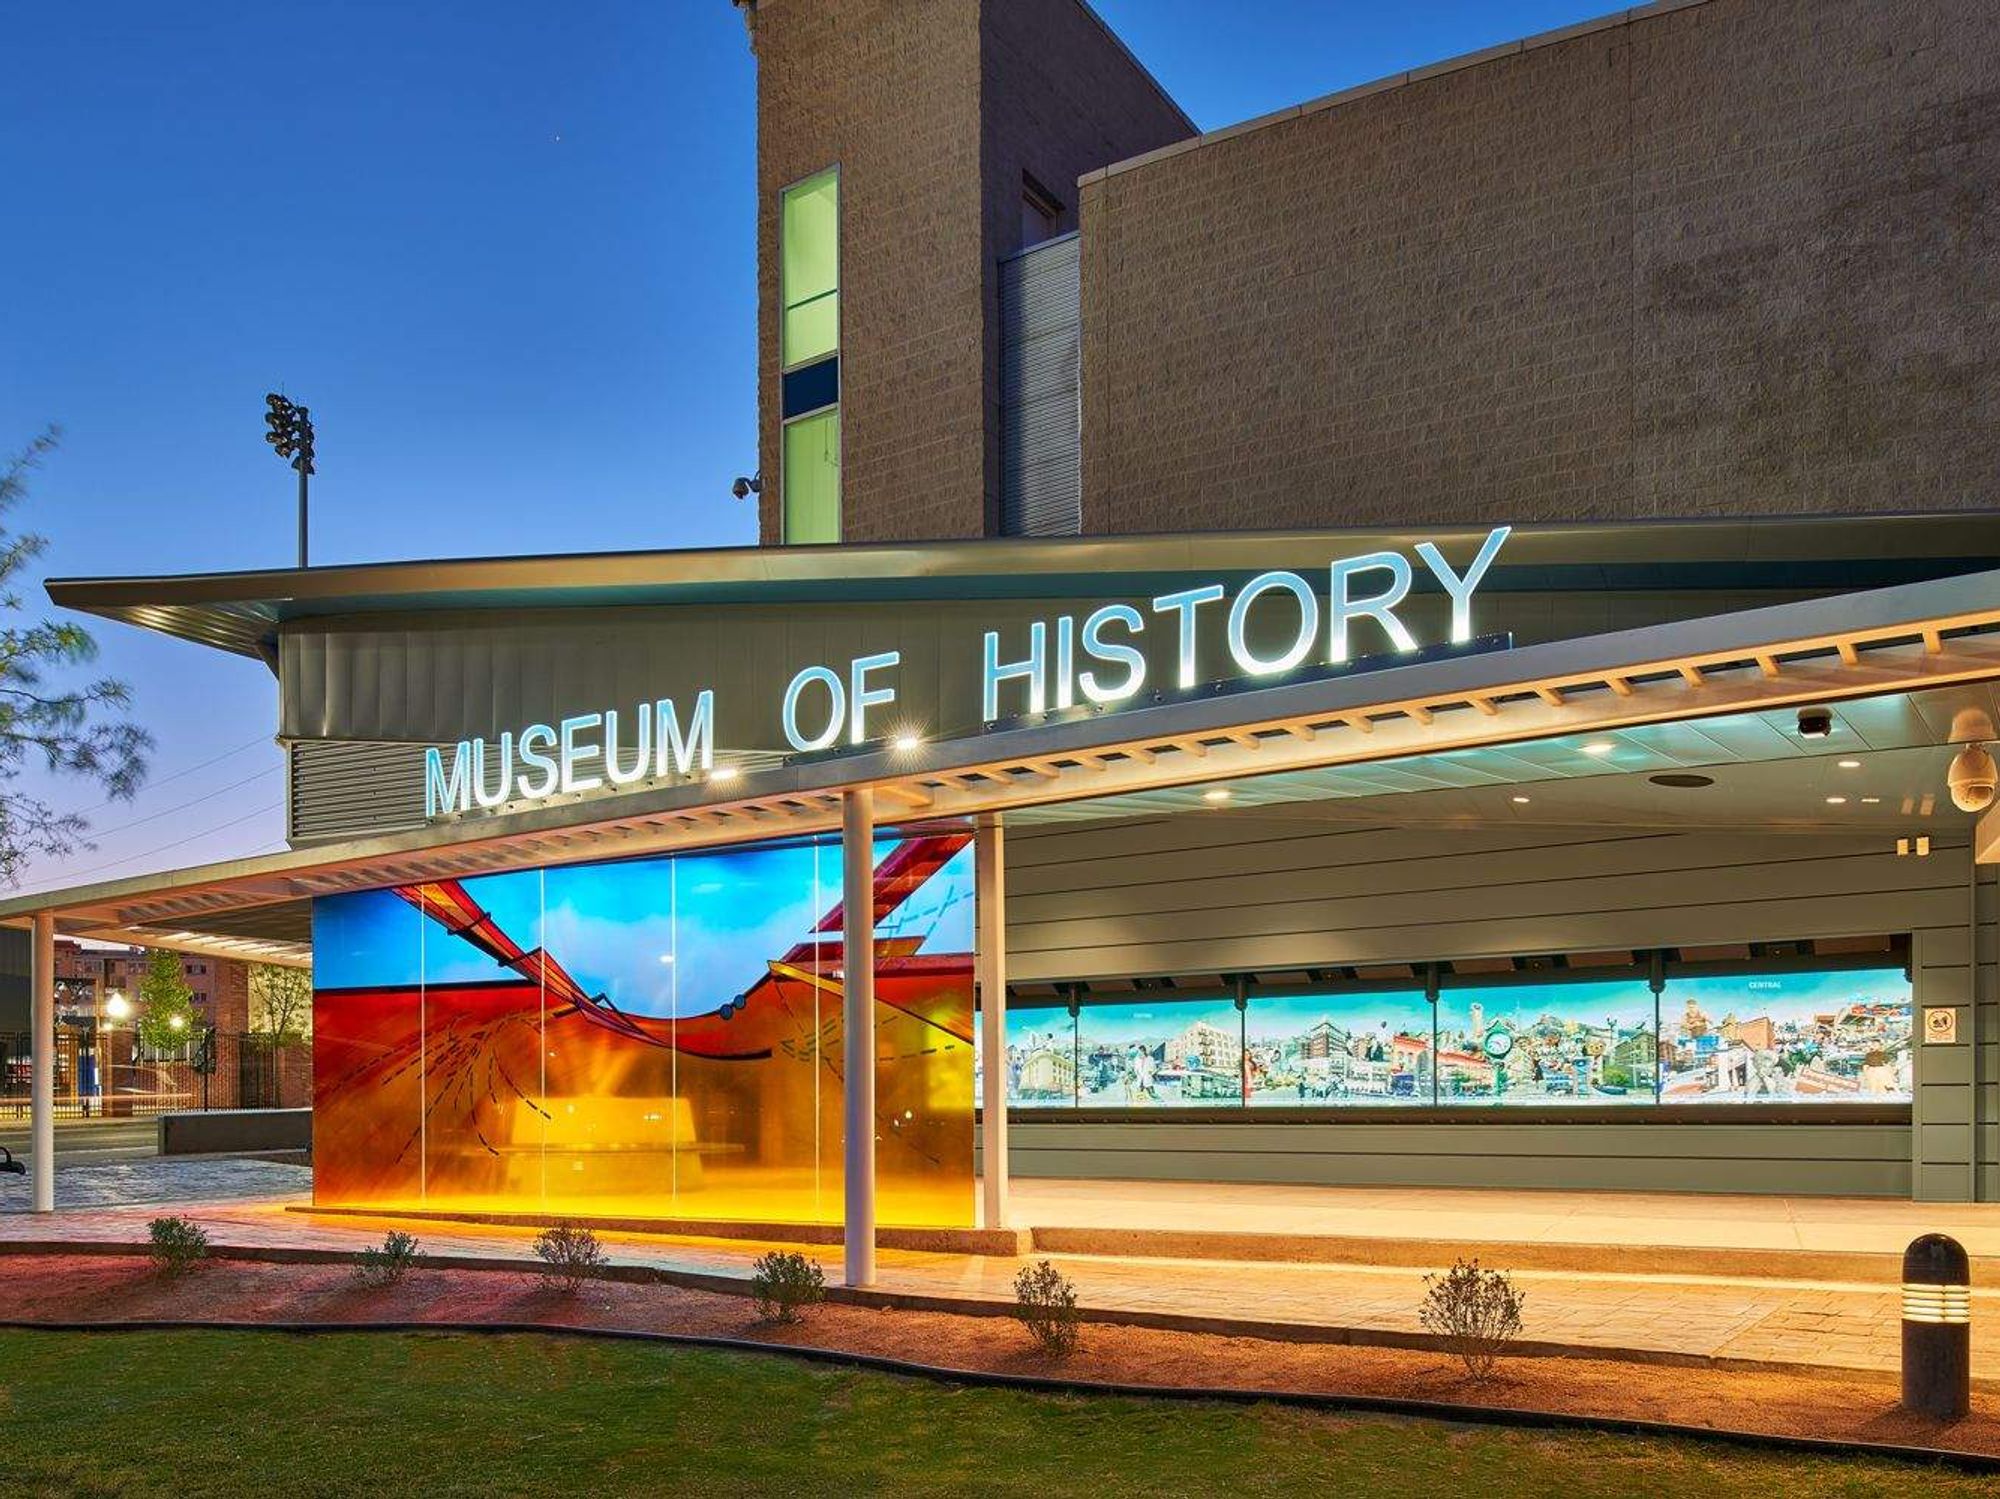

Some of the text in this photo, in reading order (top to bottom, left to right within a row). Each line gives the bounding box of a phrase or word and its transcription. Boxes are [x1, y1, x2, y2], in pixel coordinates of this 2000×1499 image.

[424, 526, 1512, 817] MUSEUM OF HISTORY
